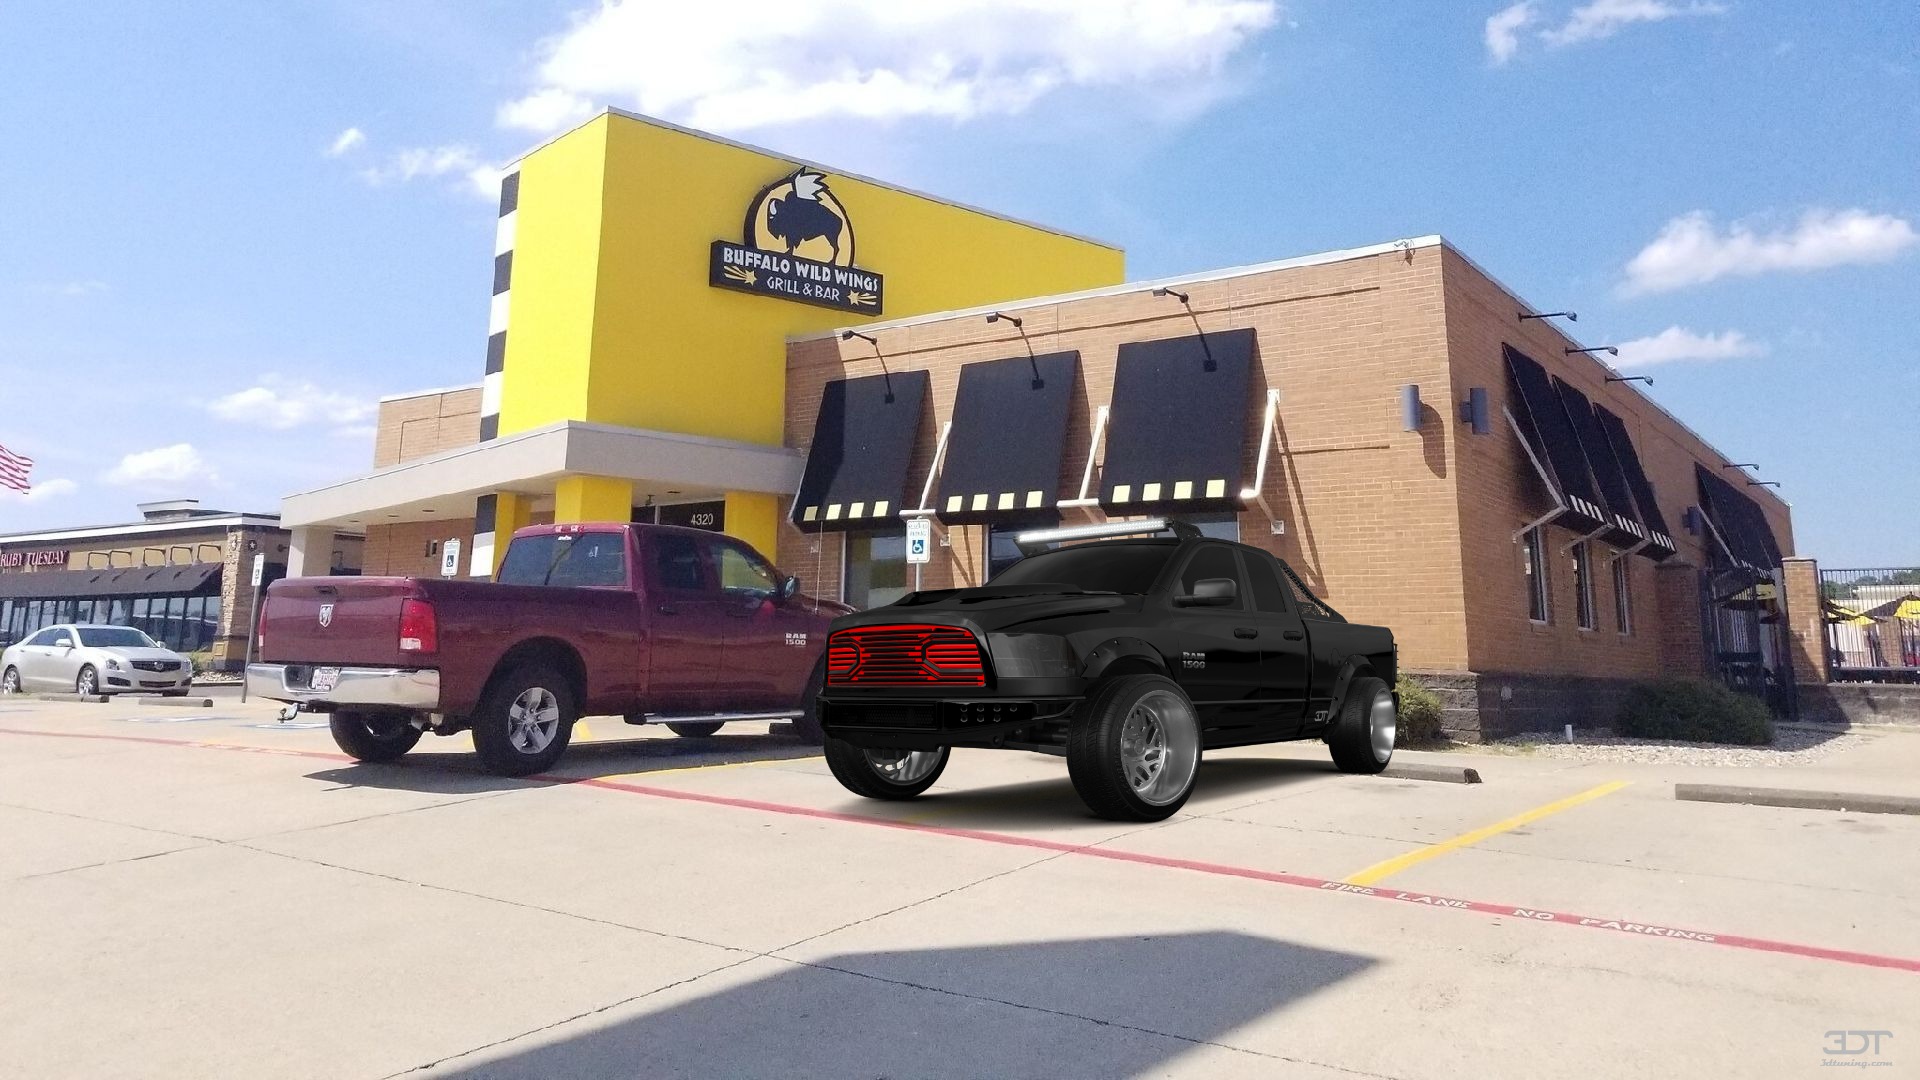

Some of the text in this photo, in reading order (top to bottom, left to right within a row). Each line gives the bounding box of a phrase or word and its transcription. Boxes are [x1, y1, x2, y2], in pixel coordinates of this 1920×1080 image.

[723, 247, 878, 292] BUFFALO WILD WINGS
[766, 276, 840, 302] GRILL & BAR
[690, 512, 713, 526] 4320
[0, 550, 66, 567] RUBY TUESDAY
[1182, 651, 1206, 660] RAM
[1182, 660, 1206, 669] 1500
[1320, 881, 1716, 943] FIRE LANE NO PARKING
